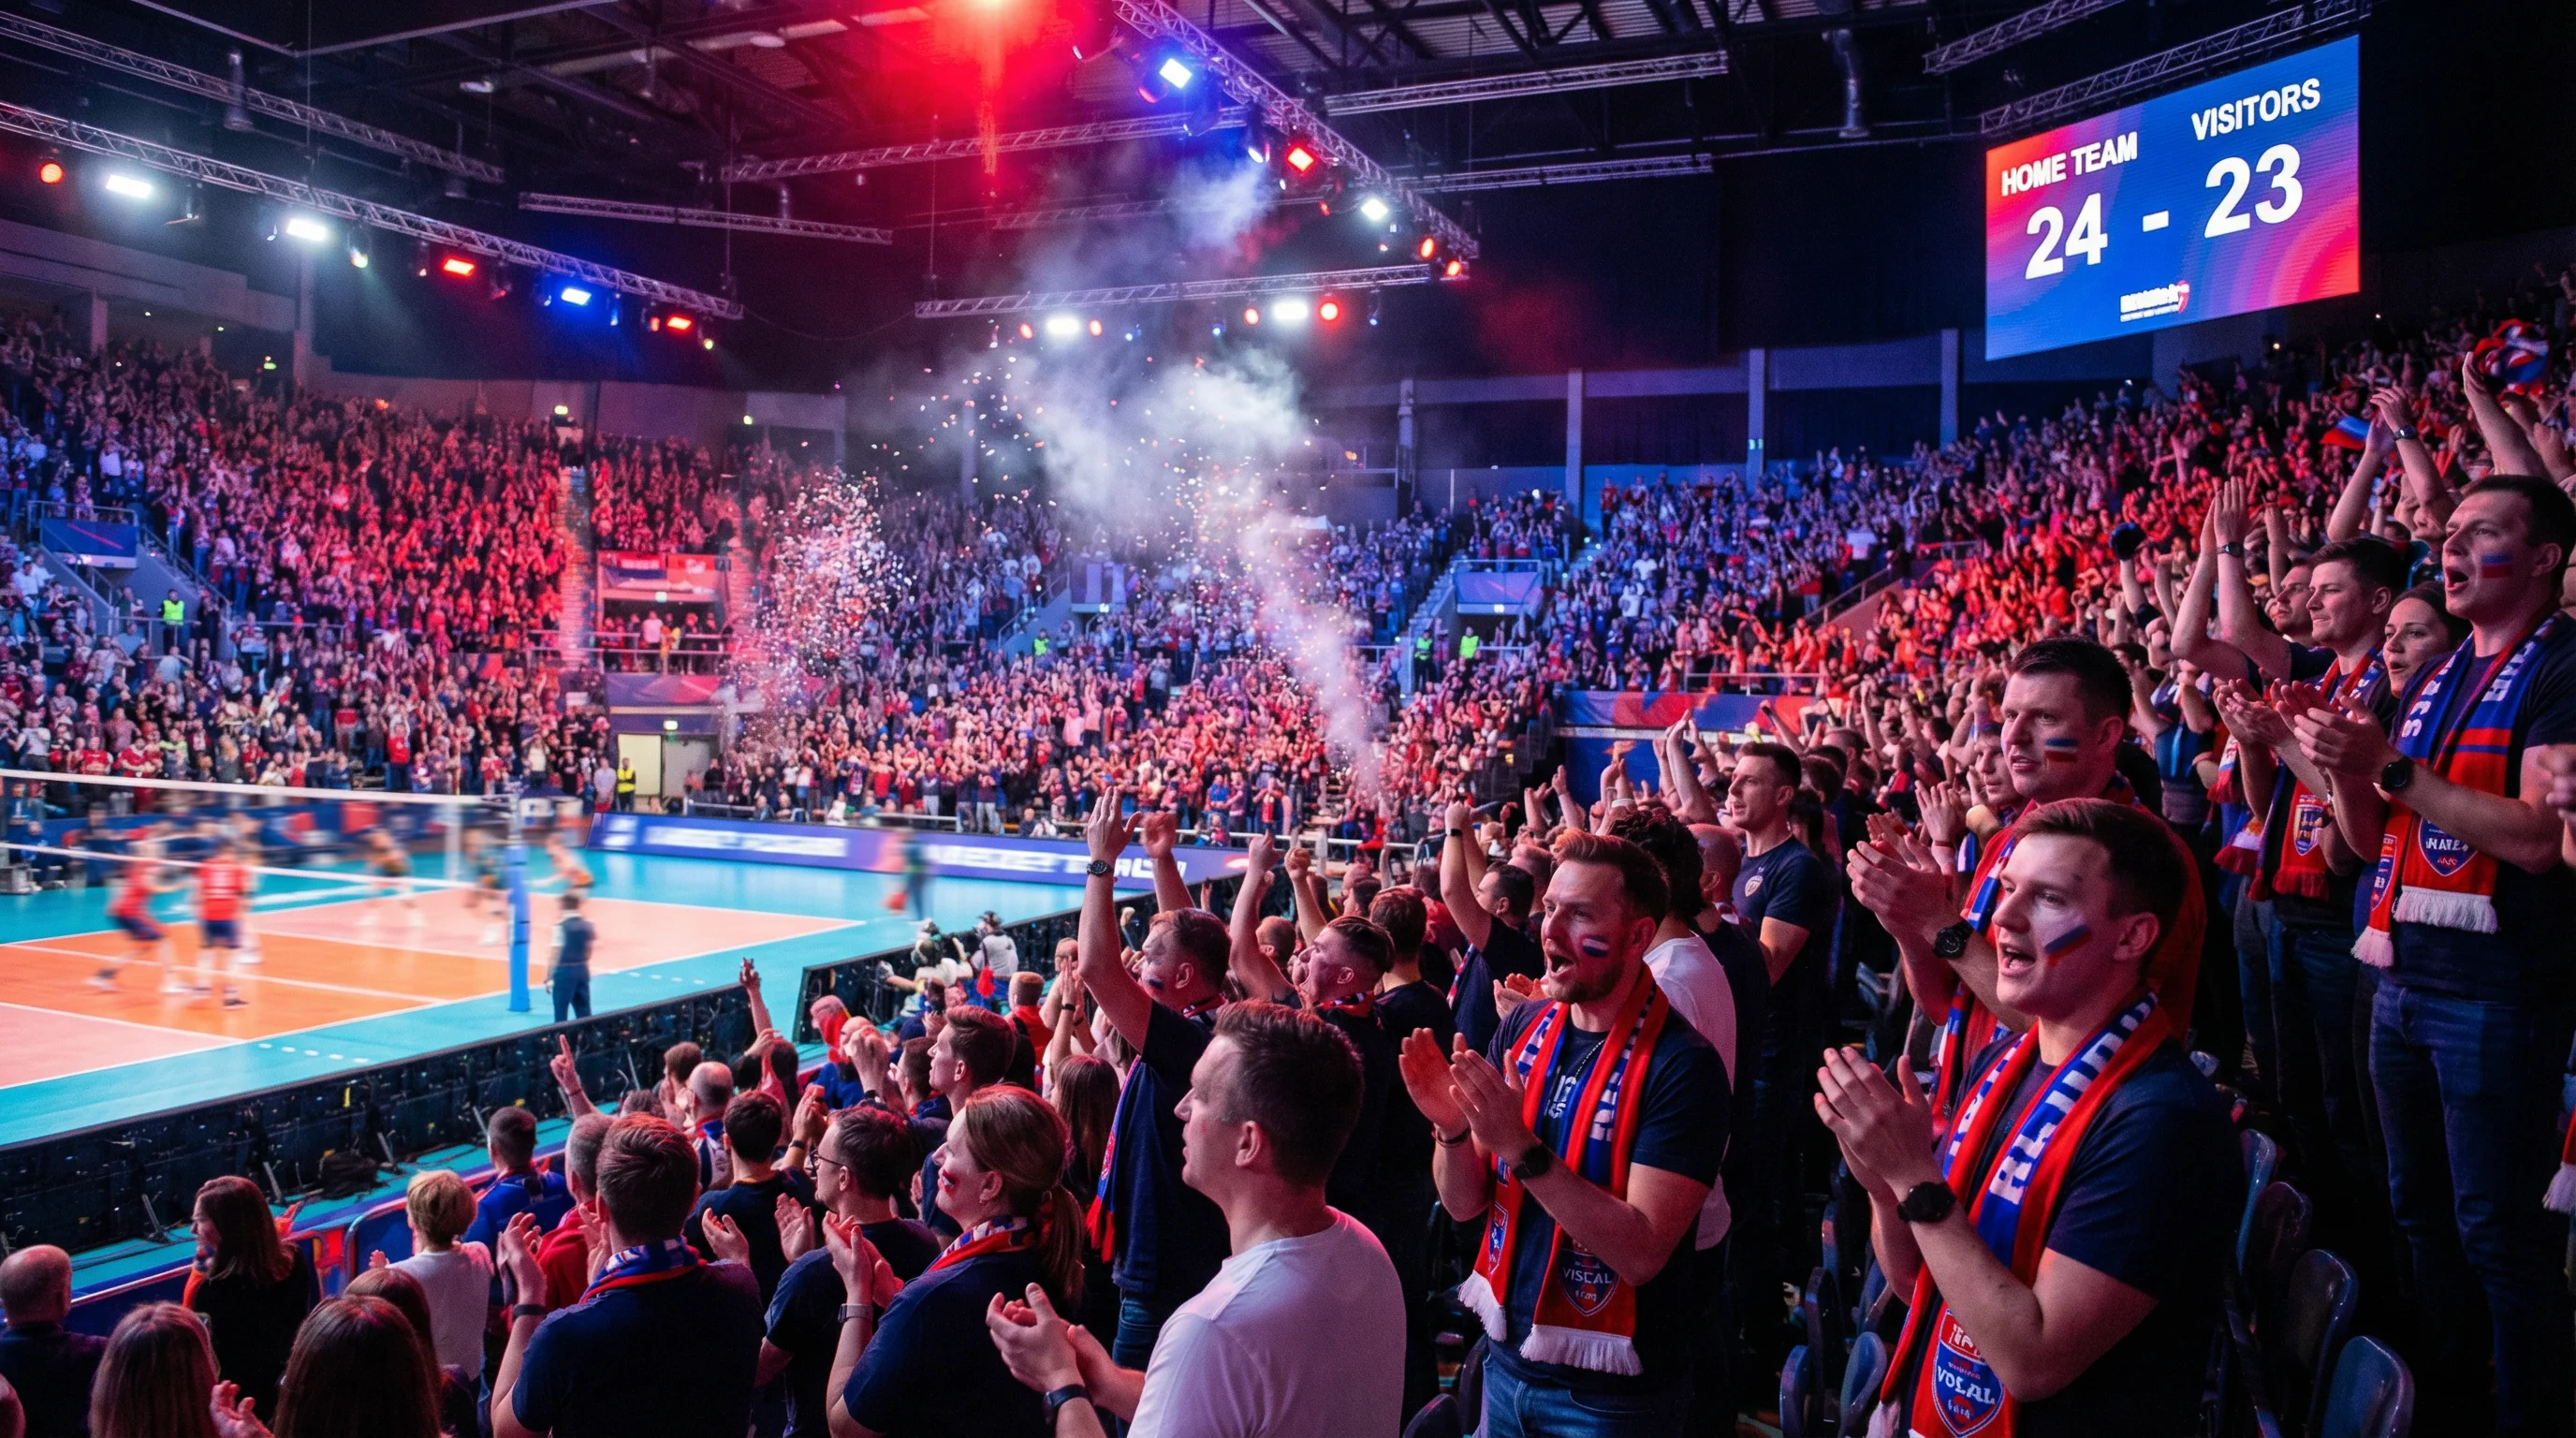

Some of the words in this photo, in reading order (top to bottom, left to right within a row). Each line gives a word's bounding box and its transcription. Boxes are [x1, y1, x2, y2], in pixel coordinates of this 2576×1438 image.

[2191, 79, 2320, 140] VISITORS
[2001, 154, 2067, 197] HOME
[2071, 131, 2138, 176] TEAM
[2025, 192, 2108, 280] 24
[2142, 211, 2169, 232] -
[2204, 143, 2303, 239] 23
